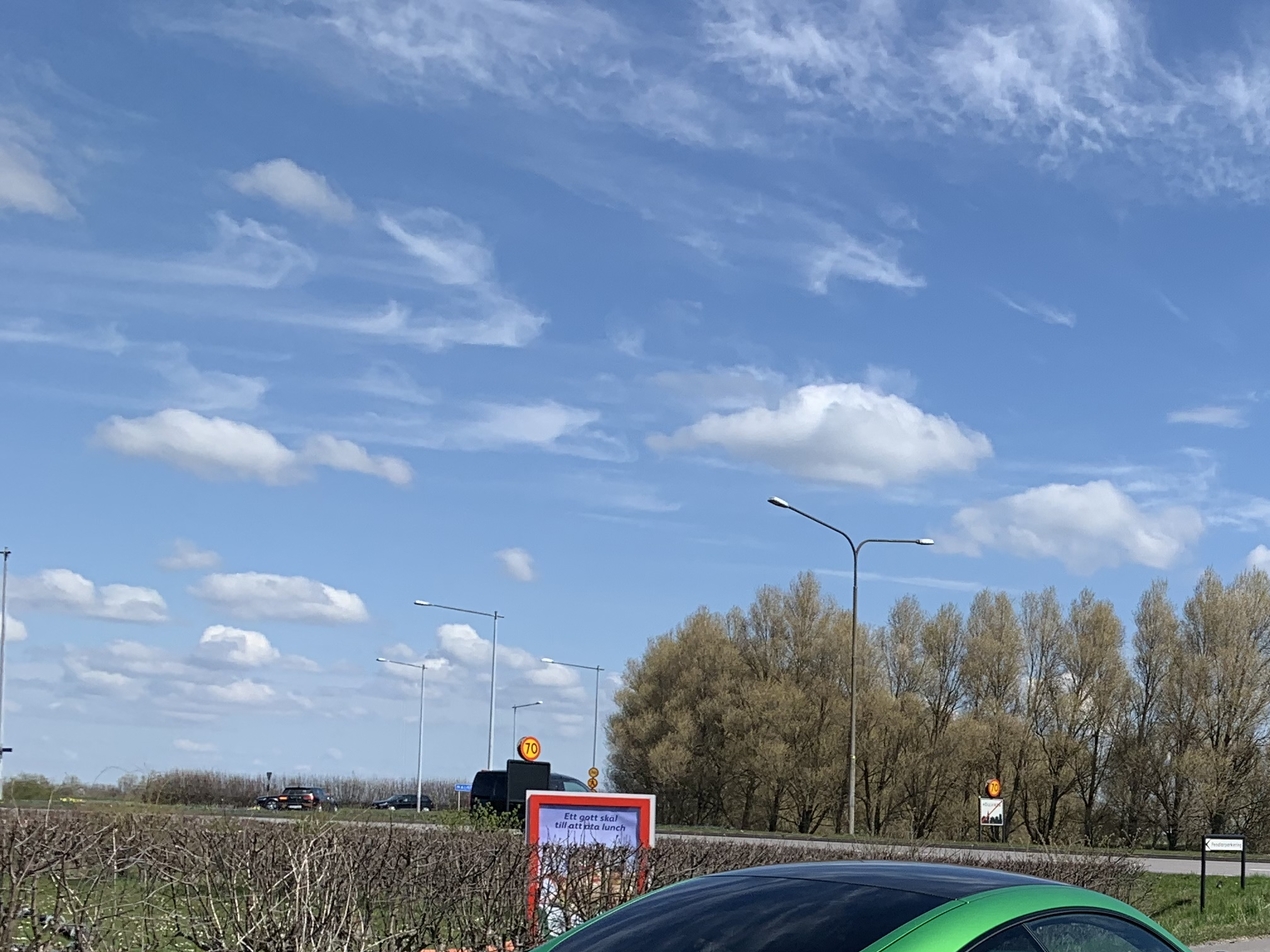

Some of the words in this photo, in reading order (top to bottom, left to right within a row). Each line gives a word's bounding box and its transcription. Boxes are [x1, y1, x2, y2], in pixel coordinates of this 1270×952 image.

[525, 742, 538, 754] 70
[991, 783, 999, 792] 70
[564, 812, 577, 821] Ett
[579, 814, 598, 823] gott
[555, 821, 568, 829] till
[568, 822, 582, 830] att
[602, 823, 626, 832] lunch
